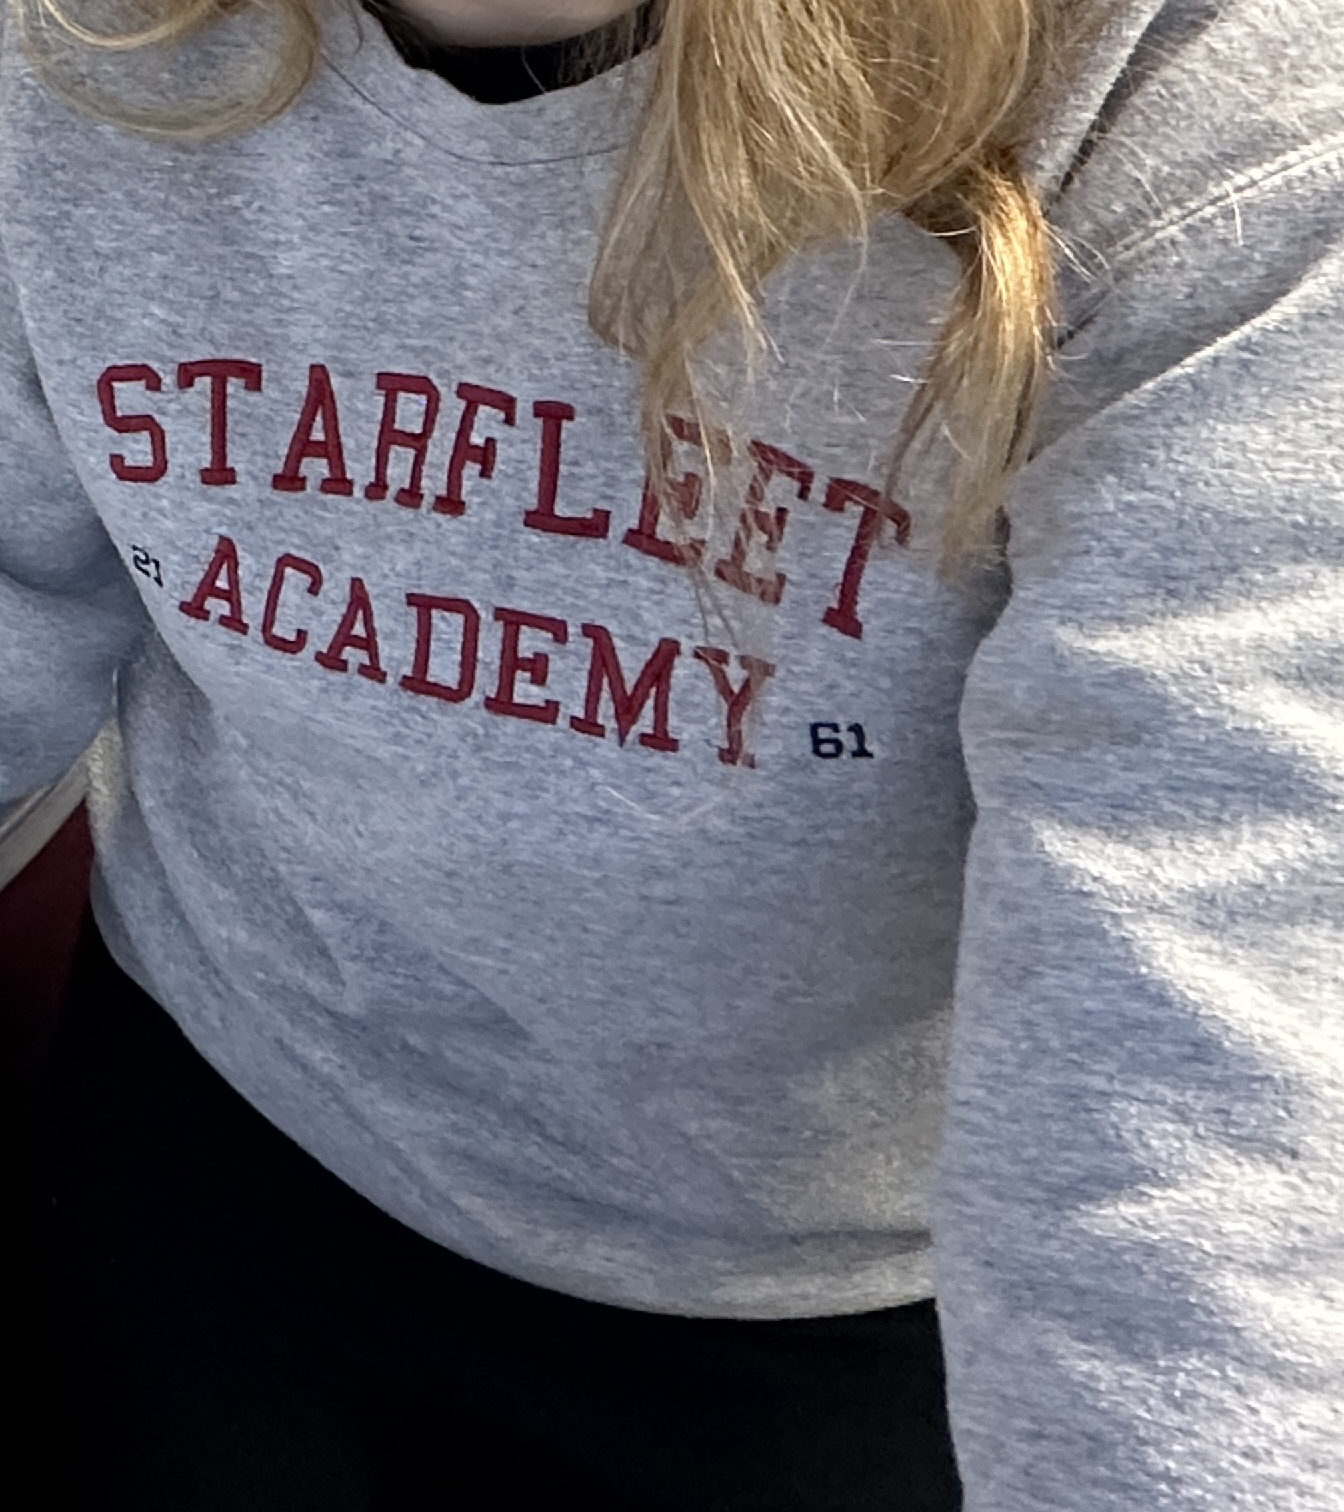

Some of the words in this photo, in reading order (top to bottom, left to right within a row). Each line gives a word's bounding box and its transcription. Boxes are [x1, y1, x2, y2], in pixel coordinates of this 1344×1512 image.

[95, 357, 911, 640] STARFLEET
[177, 533, 777, 768] ACADEMY
[809, 722, 875, 760] 61
